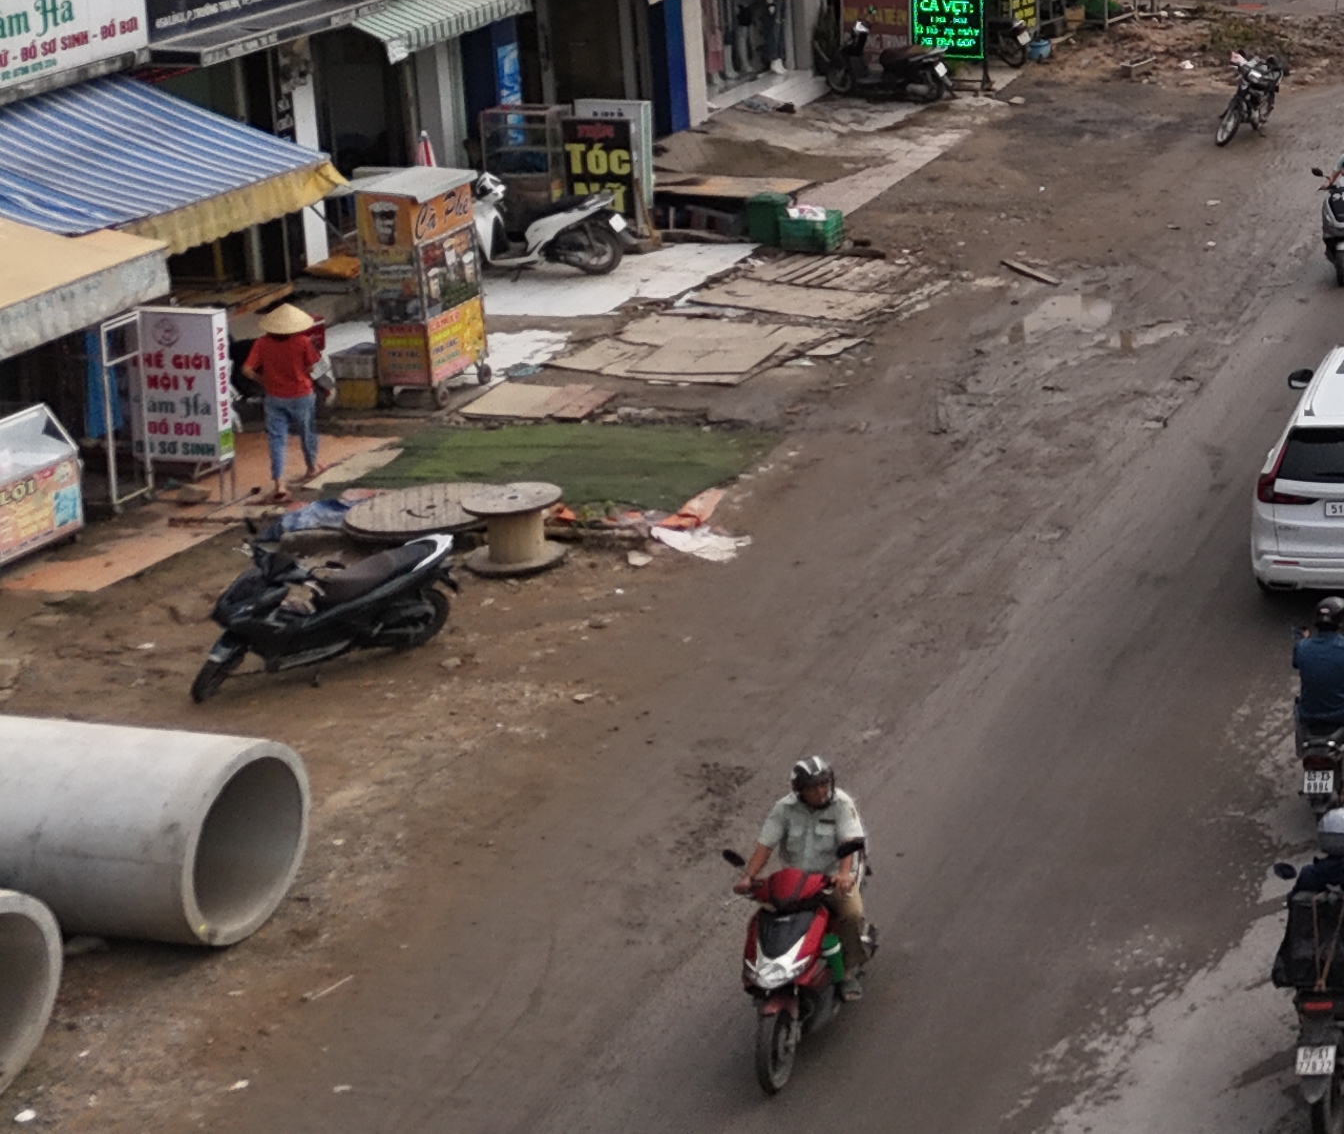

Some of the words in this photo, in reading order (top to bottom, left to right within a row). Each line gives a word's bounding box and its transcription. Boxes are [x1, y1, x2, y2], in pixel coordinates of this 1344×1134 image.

[60, 30, 89, 51] SINH
[172, 352, 211, 370] GIỚI
[147, 372, 178, 393] NỘI
[183, 375, 196, 391] Y
[182, 443, 215, 457] SINH
